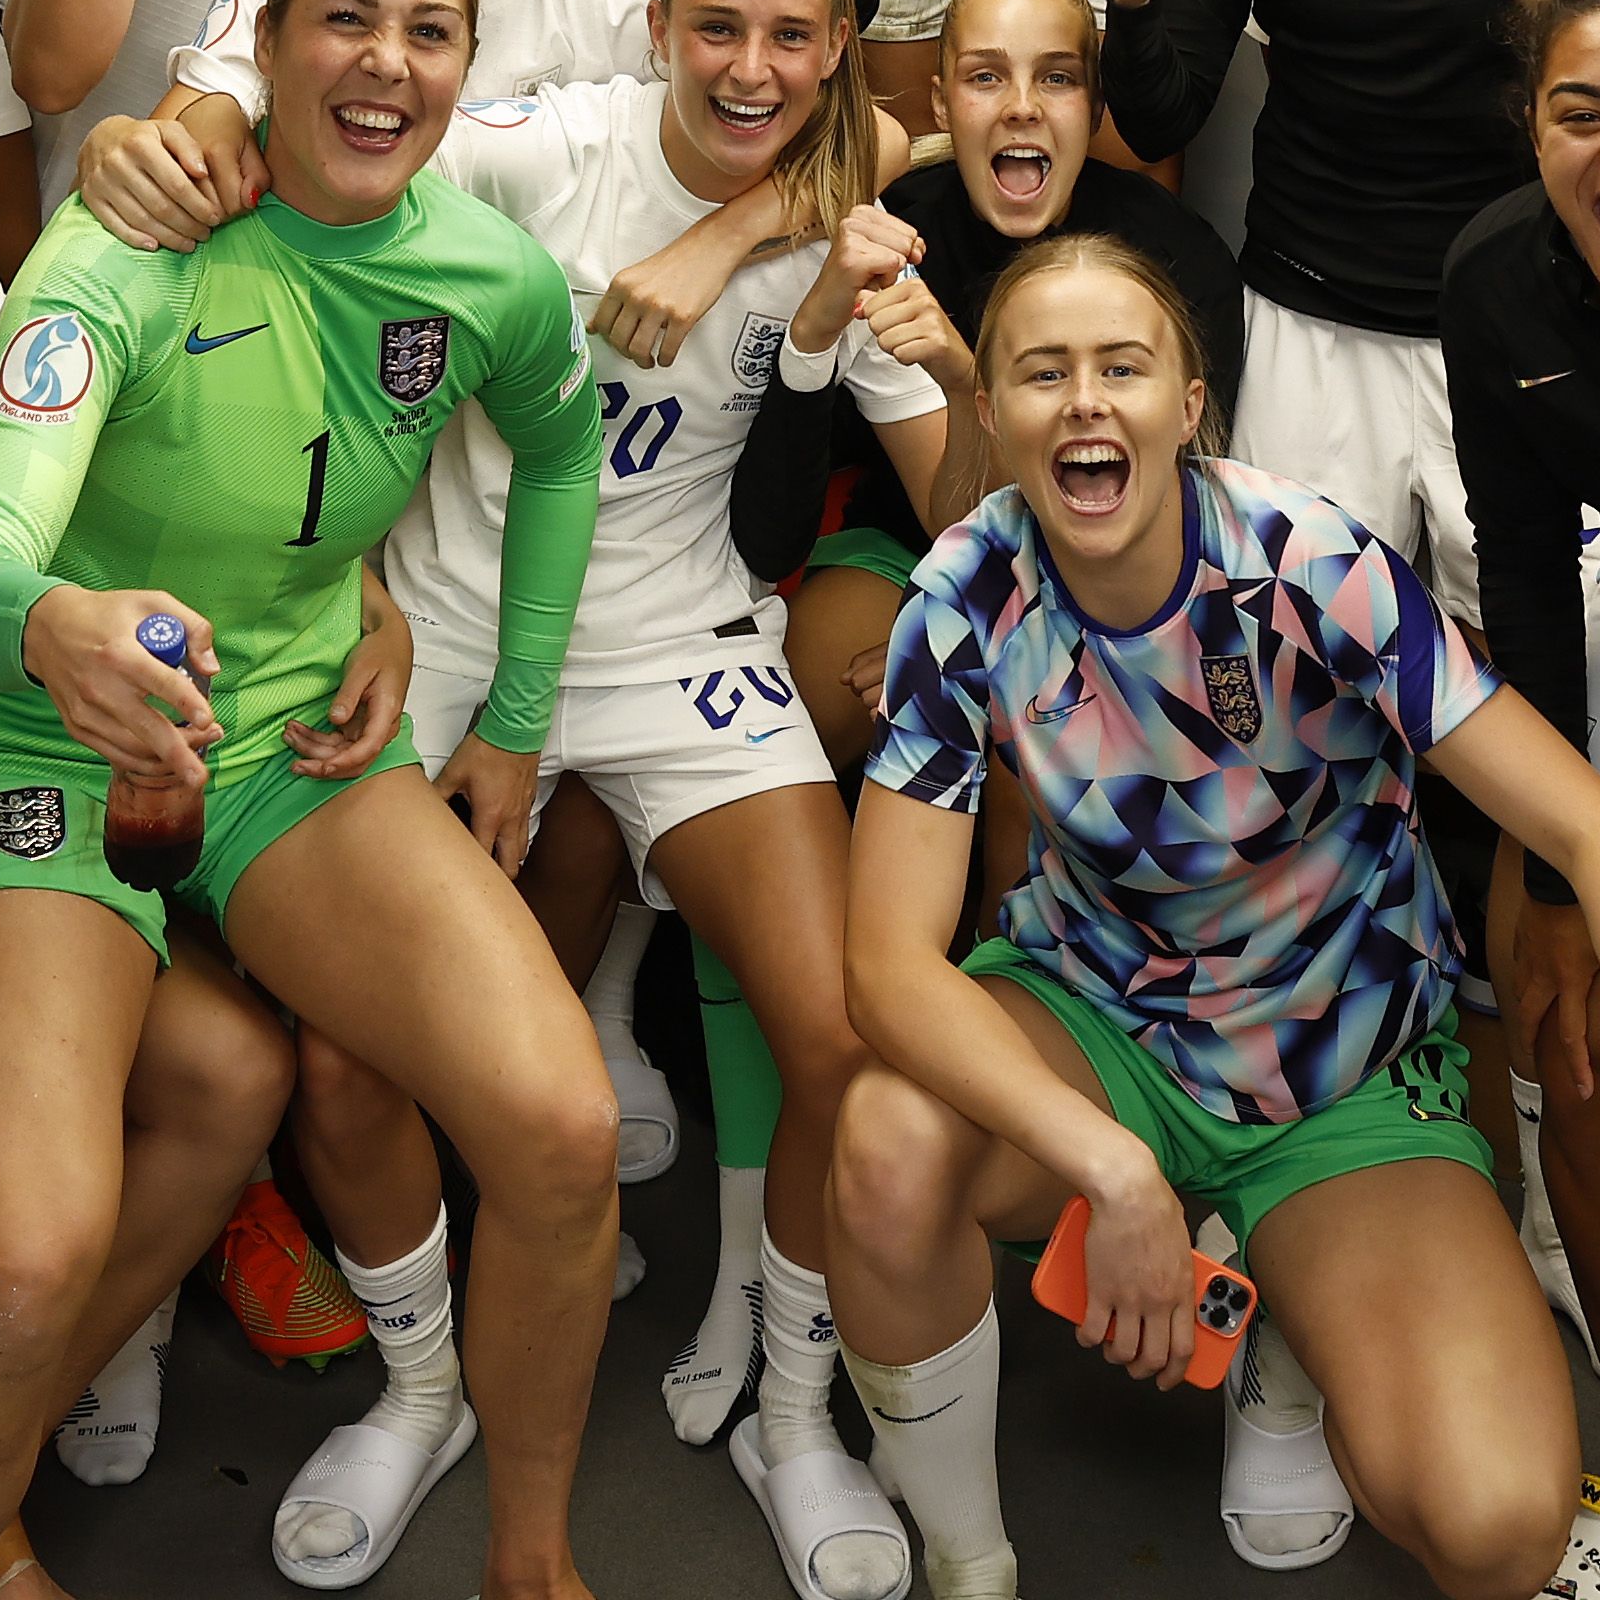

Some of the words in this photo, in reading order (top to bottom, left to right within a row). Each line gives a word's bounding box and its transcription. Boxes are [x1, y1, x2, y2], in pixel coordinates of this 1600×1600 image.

[46, 413, 70, 423] 2022
[283, 428, 331, 548] 1
[691, 1367, 722, 1382] RIGHT
[101, 1422, 137, 1436] RIGHT
